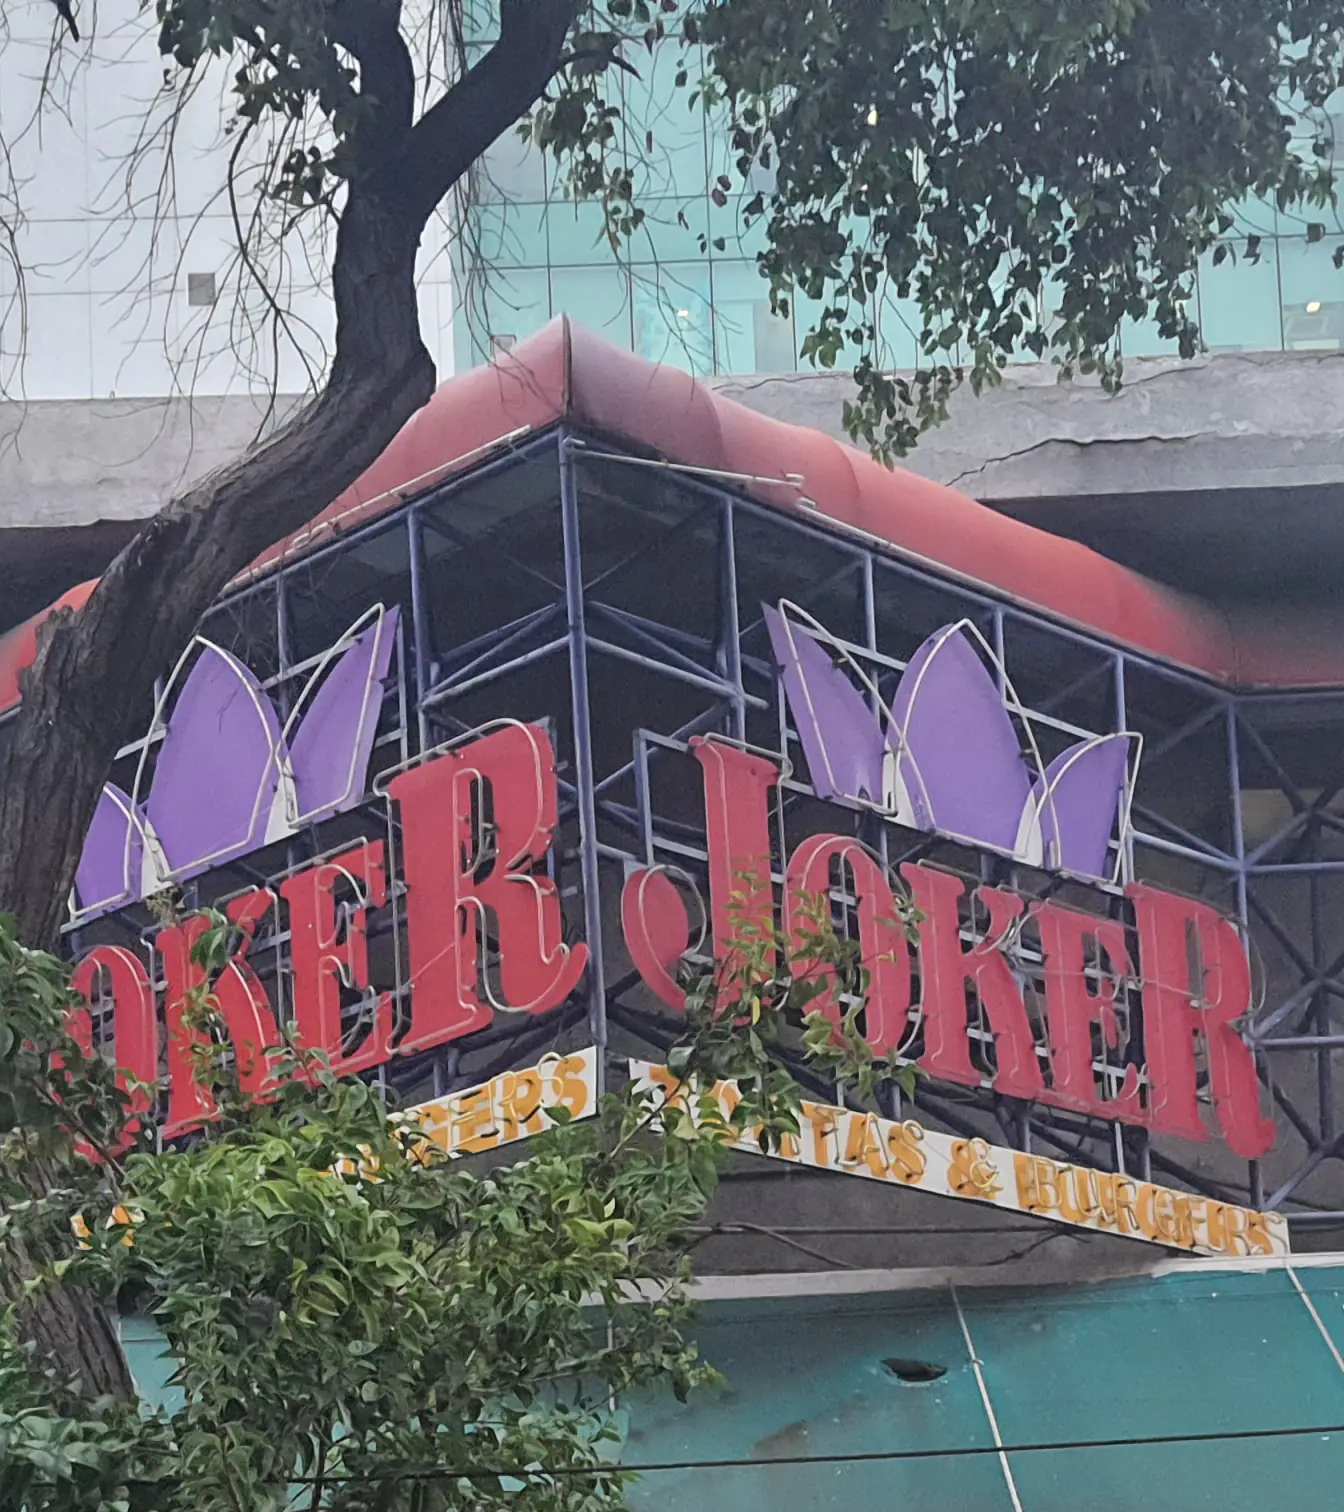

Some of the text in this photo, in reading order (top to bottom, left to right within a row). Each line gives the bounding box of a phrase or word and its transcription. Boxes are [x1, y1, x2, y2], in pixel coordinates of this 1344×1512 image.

[46, 722, 590, 1168] OKER
[621, 733, 1279, 1160] JOKER
[1013, 1153, 1287, 1258] BURGERS
